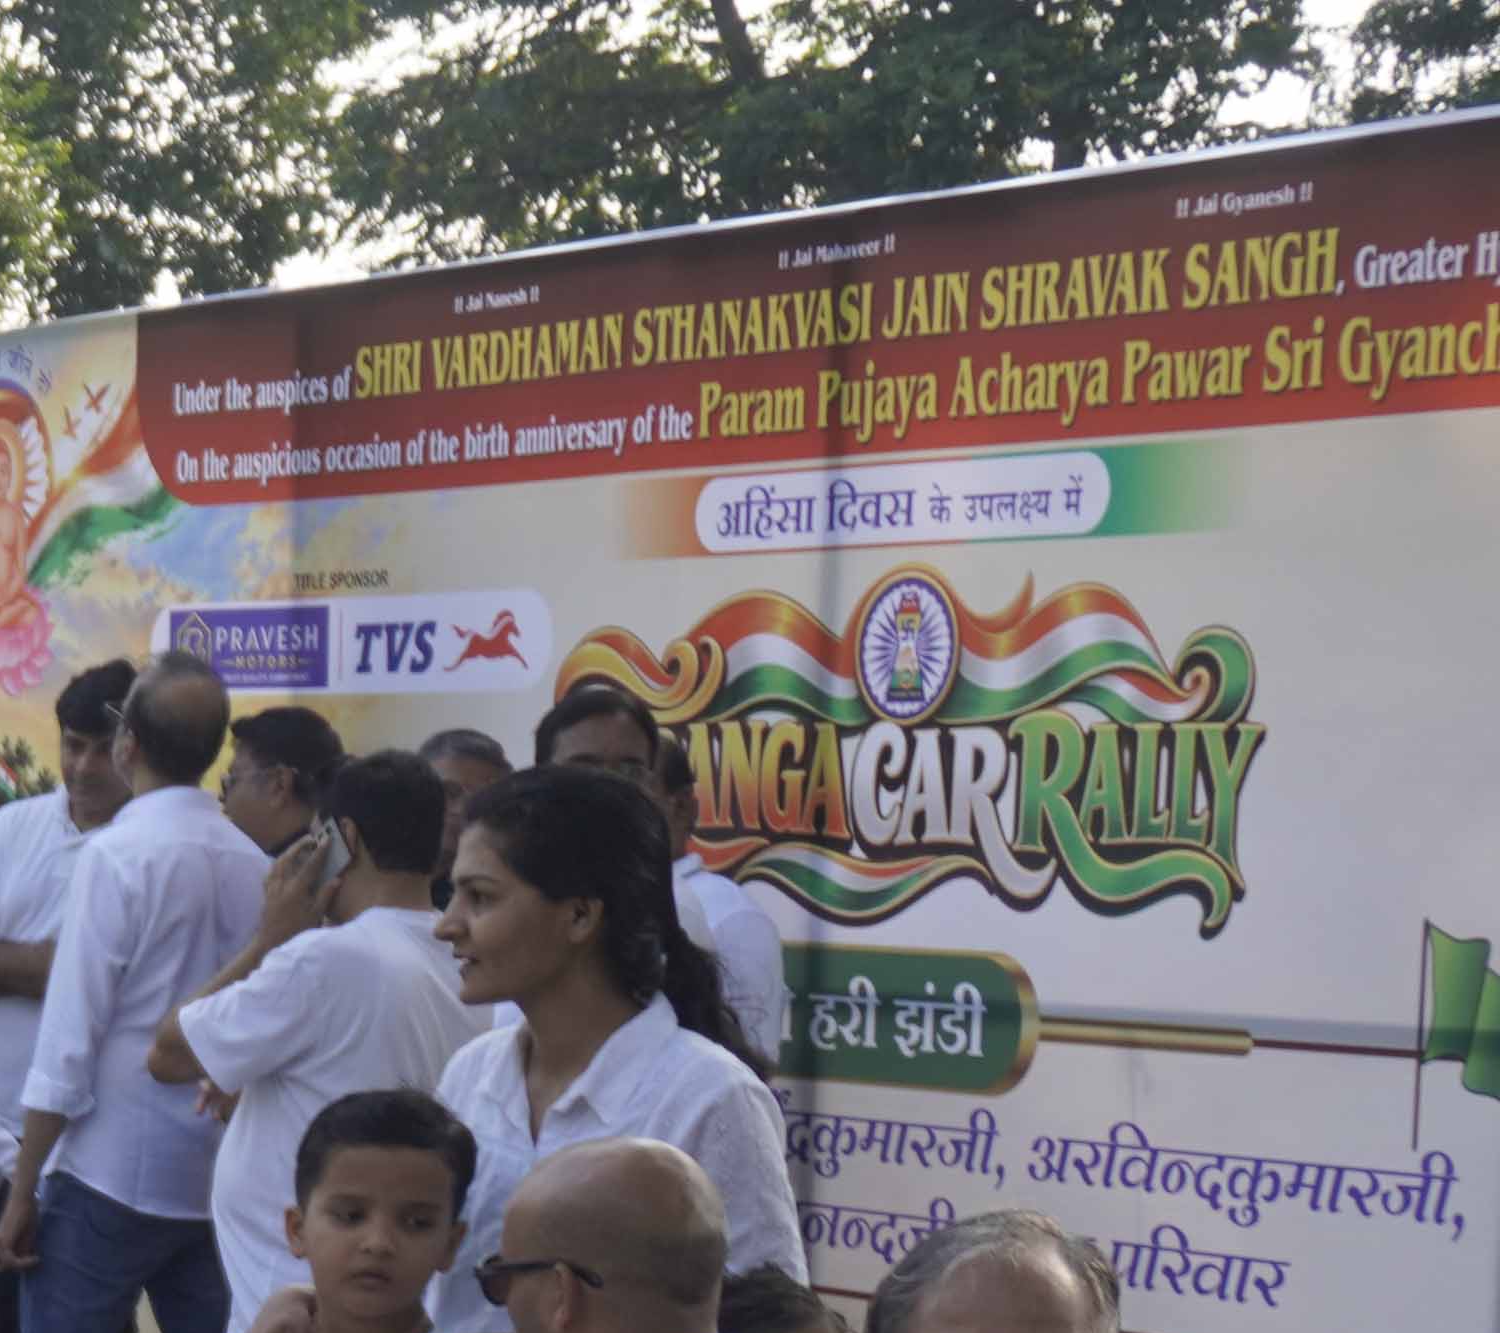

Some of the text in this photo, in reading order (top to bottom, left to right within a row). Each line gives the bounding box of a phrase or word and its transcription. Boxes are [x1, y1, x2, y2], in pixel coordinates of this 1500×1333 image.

[1193, 193, 1219, 217] Jai
[1222, 184, 1295, 217] Gyanesh
[173, 382, 220, 416] Under
[224, 378, 252, 411] the
[256, 369, 328, 417] auspices
[333, 365, 354, 400] of
[355, 339, 423, 399] SHRI
[432, 312, 624, 391] VARDHAMAN
[632, 283, 873, 368] STHANAKVASI
[882, 272, 971, 340] JAIN
[979, 248, 1171, 331] SHRAVAK
[1182, 227, 1345, 310] SANGH,
[1354, 237, 1469, 289] Greater
[176, 449, 198, 484] On
[203, 446, 229, 481] the
[233, 441, 320, 487] auspicious
[325, 433, 401, 472] occasion
[406, 429, 428, 467] of
[429, 427, 458, 464] the
[464, 422, 510, 462] birth
[515, 413, 627, 457] anniversary
[632, 404, 655, 444] of
[656, 402, 693, 442] the
[699, 380, 805, 439] Param
[817, 360, 937, 443] Pujaya
[949, 352, 1108, 428] Acharya
[1121, 339, 1251, 405] Pawar
[1262, 316, 1324, 393] Sri
[716, 474, 1085, 540] अहिंसा दिवस के उपलक्ष्य में
[329, 569, 389, 589] SPONSOR
[215, 624, 320, 653] PRAVESH
[355, 620, 438, 675] TVS
[686, 710, 1267, 932] ANGA CAR RALLY
[808, 974, 880, 1051] हरी
[893, 979, 988, 1059] झंडी
[784, 1107, 1468, 1243] द्रकुमारजी, अरविन्दकुमारजी,
